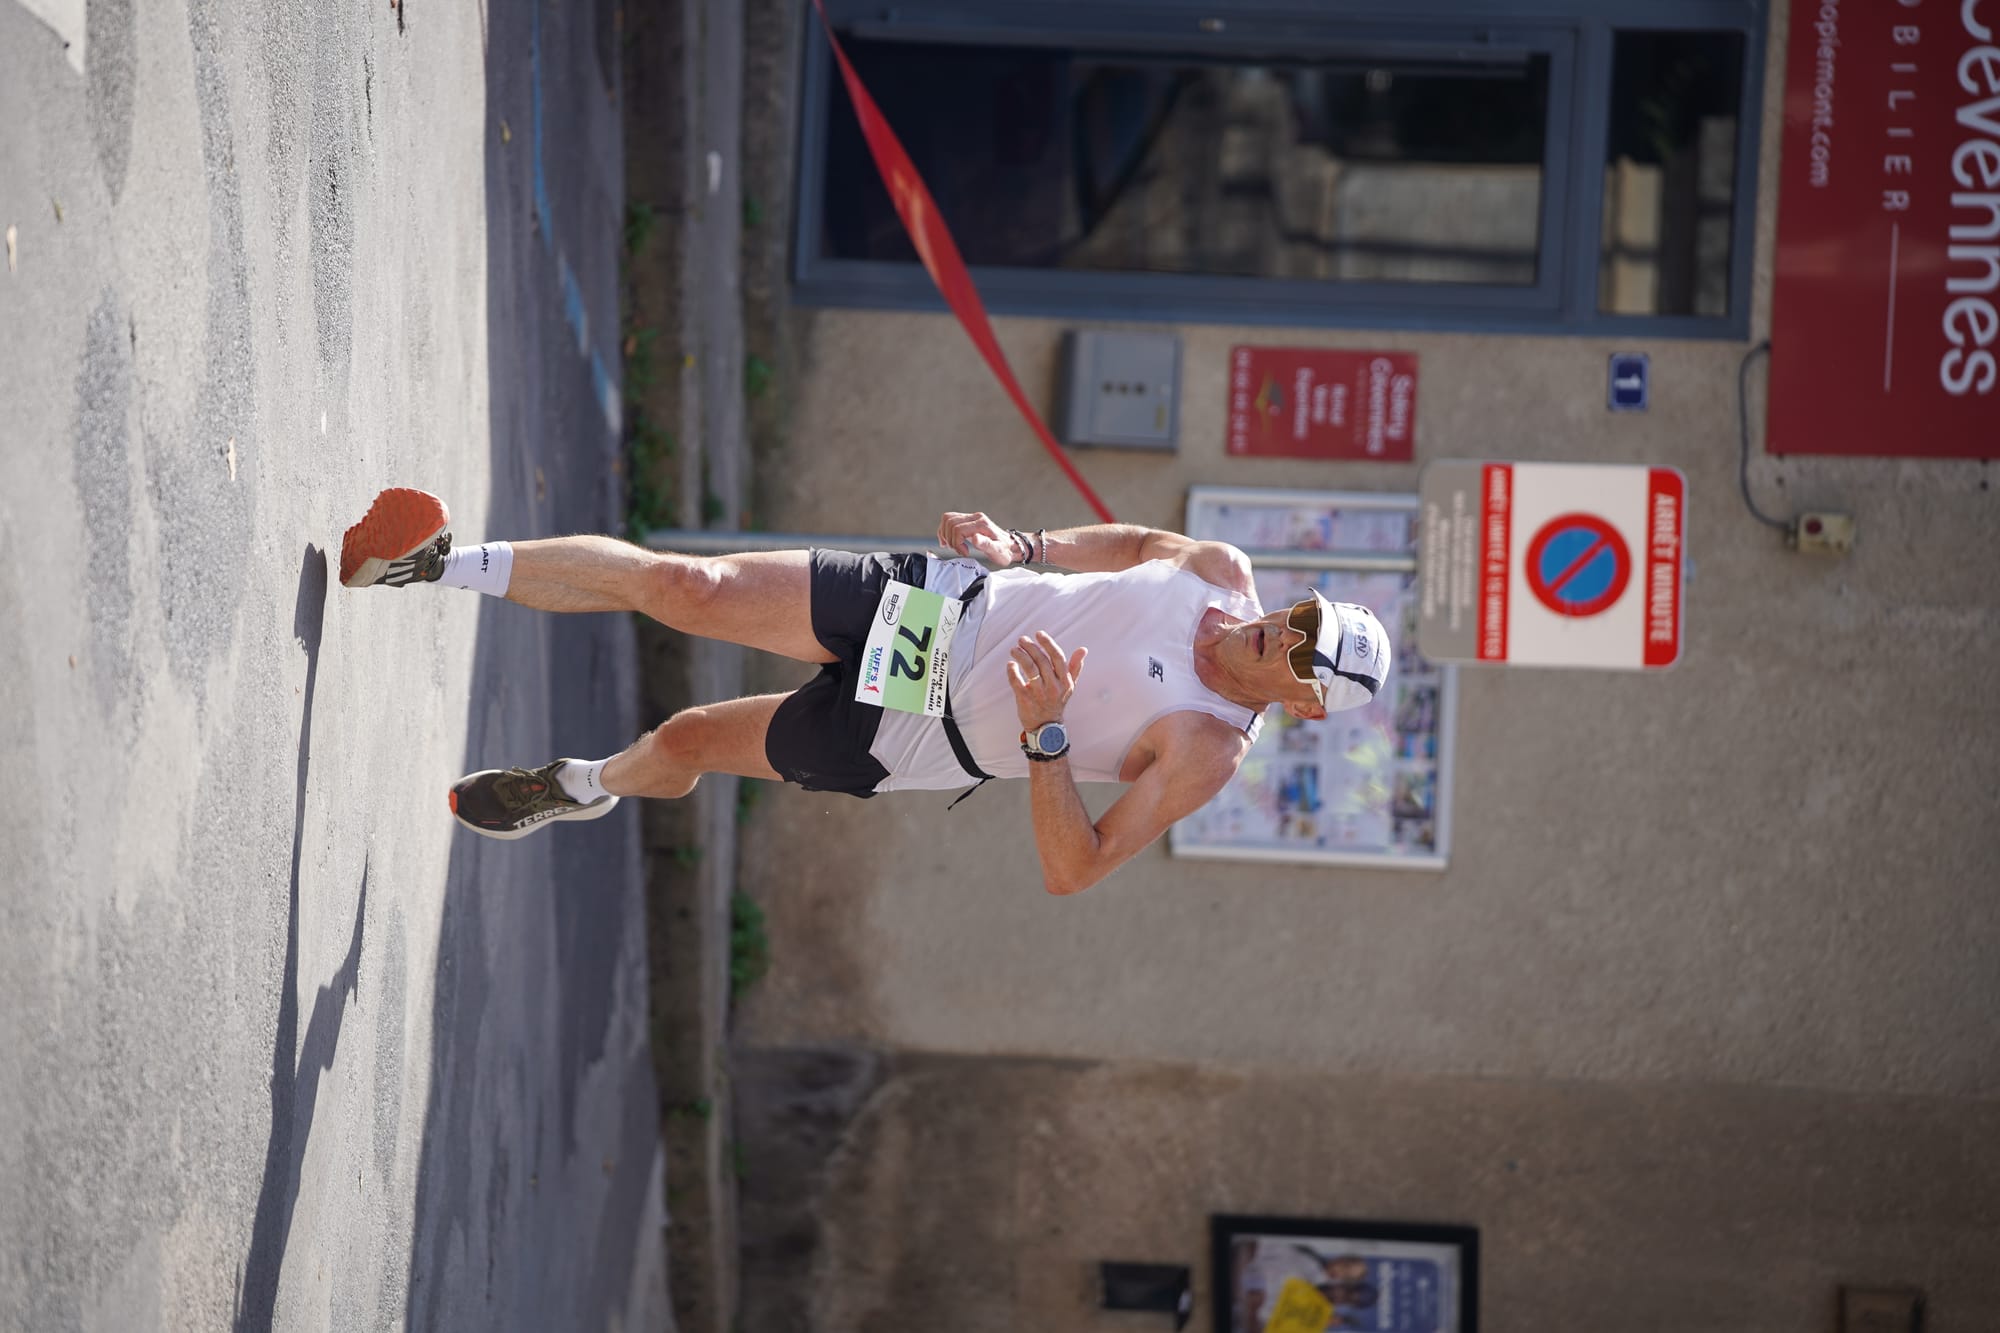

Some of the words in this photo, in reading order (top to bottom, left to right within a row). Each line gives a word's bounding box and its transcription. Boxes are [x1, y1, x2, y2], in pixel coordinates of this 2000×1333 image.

[1809, 0, 1842, 187] opiemont.com
[1614, 373, 1641, 390] 1
[1652, 494, 1680, 556] ARRÊT
[1484, 594, 1503, 658] MINUTES
[1650, 563, 1675, 644] MINUTE
[864, 647, 876, 684] Aventure
[870, 646, 883, 682] TUFF'S
[890, 625, 932, 681] 72
[936, 652, 948, 690] Challenge
[935, 695, 943, 708] des
